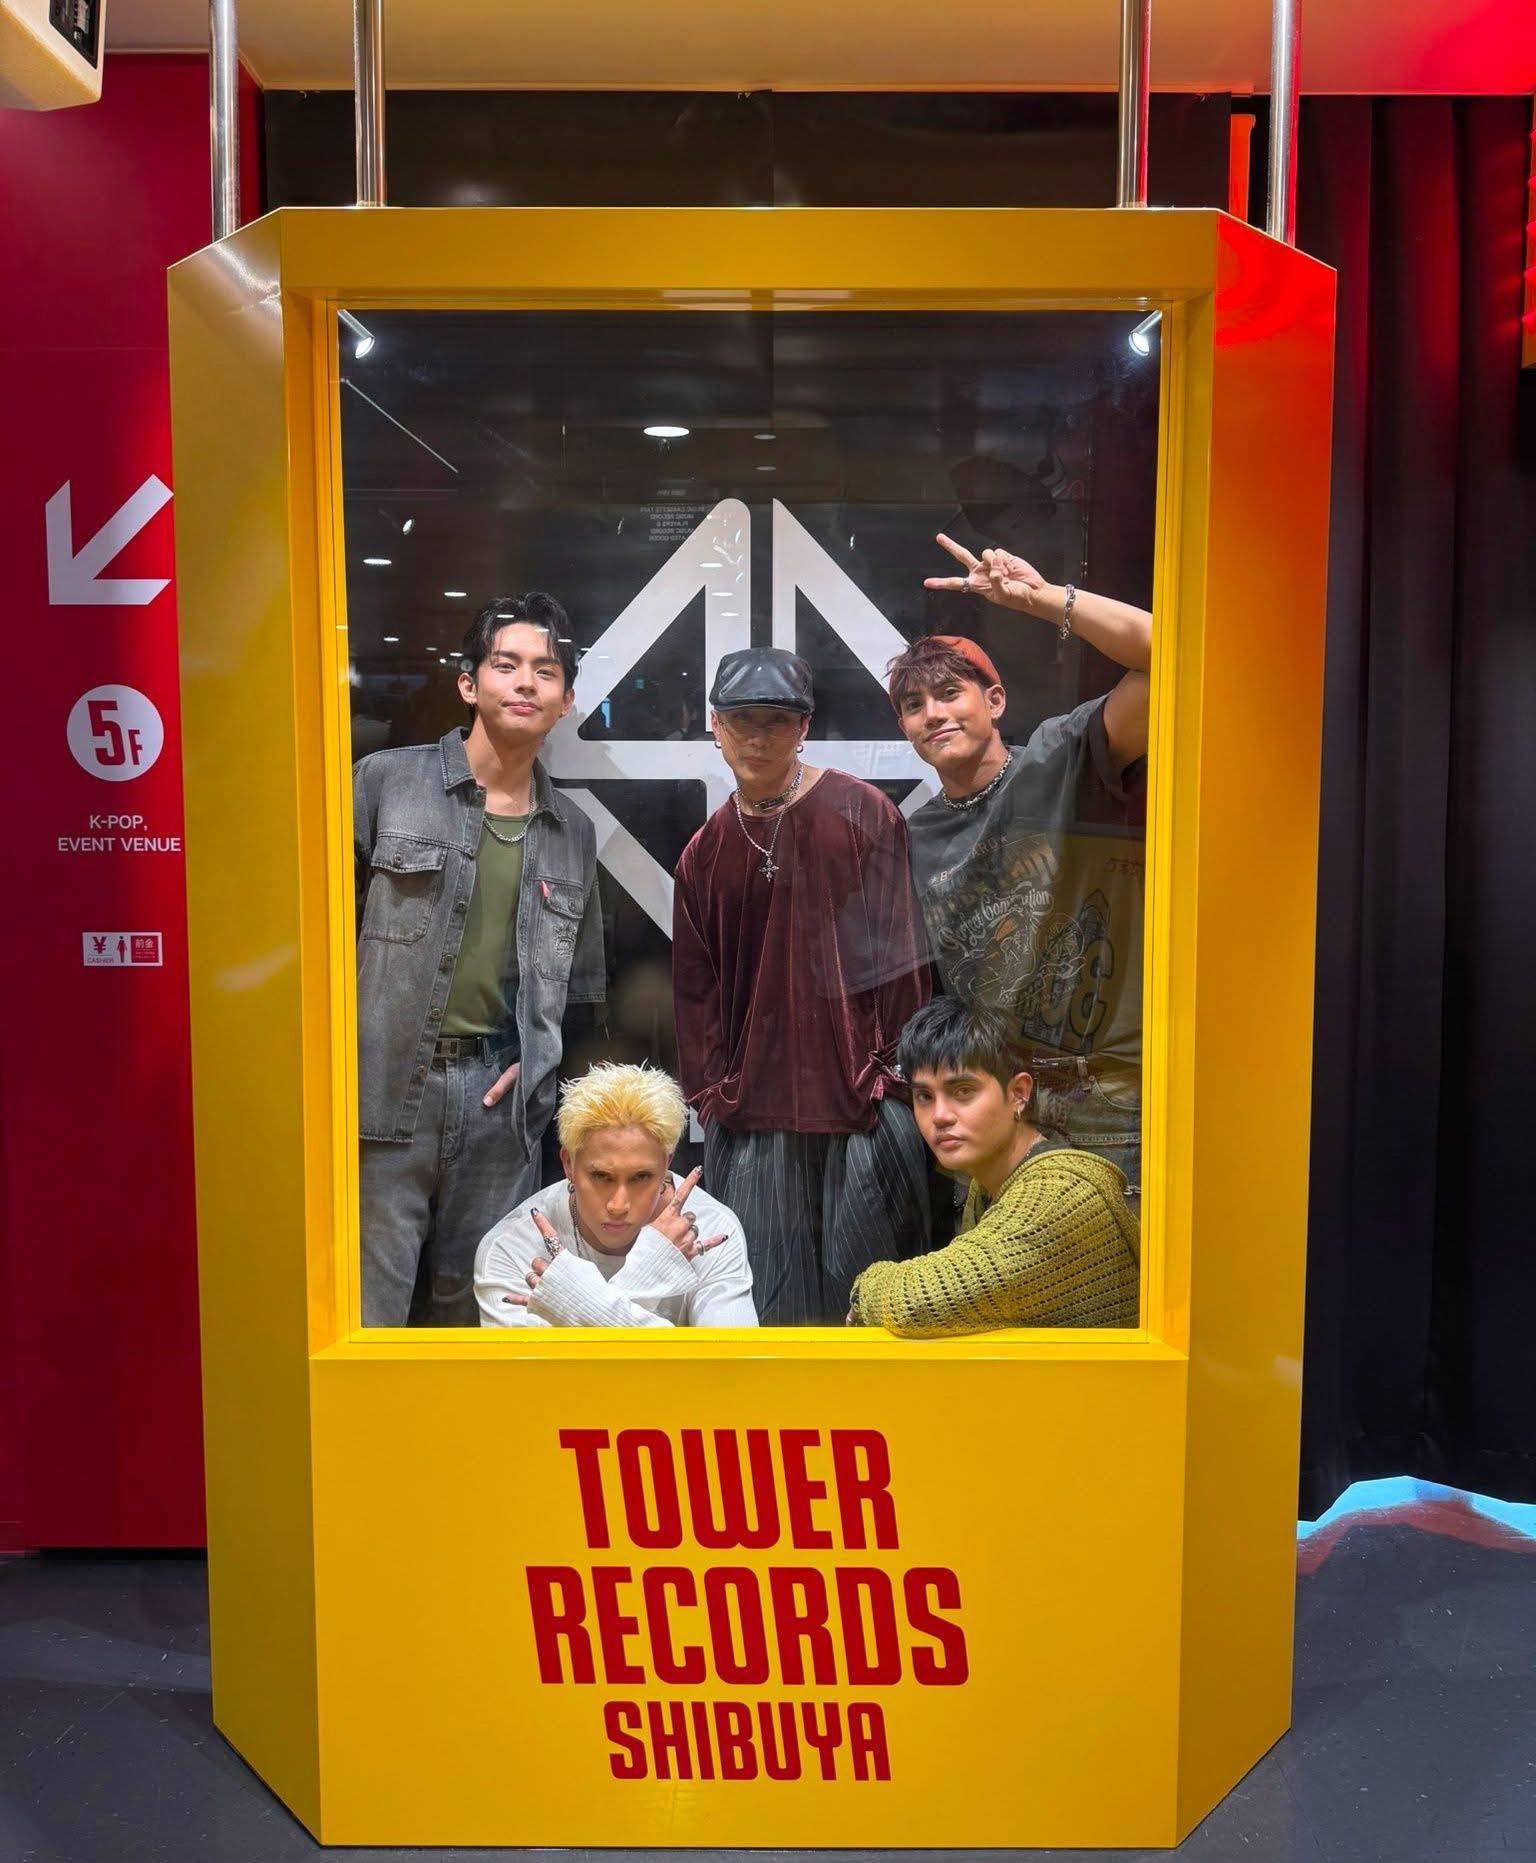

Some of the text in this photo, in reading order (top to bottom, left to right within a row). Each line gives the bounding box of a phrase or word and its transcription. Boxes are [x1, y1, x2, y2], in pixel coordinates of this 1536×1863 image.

[87, 700, 144, 766] 5F
[58, 837, 182, 852] EVENT VENUE
[89, 815, 148, 831] K-POP,
[558, 1428, 900, 1550] TOWER
[525, 1565, 969, 1686] RECORDS
[603, 1700, 892, 1781] SHIBUYA
